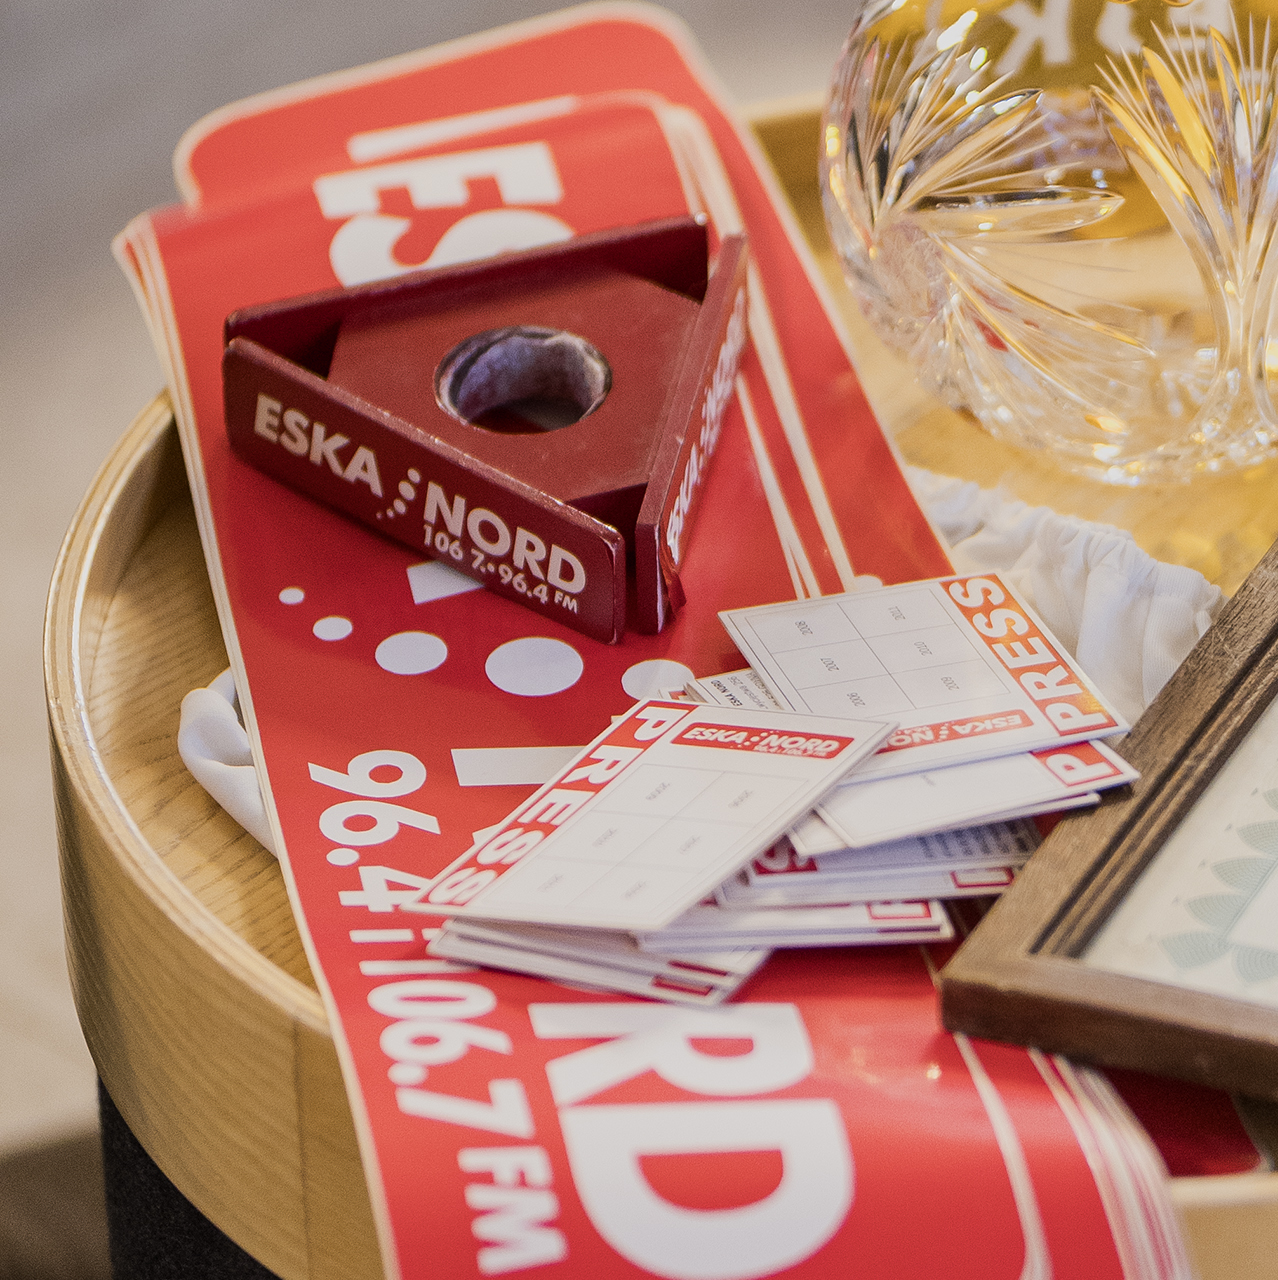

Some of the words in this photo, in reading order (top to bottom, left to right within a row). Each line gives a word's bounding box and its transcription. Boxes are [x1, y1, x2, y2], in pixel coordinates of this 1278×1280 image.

[252, 393, 384, 498] ESKA
[423, 481, 587, 595] NORD
[554, 590, 579, 614] FM
[948, 577, 1109, 732] PRESS
[682, 726, 749, 744] ESKA
[759, 733, 841, 753] NORD
[885, 729, 935, 748] NO
[952, 714, 1022, 735] ESKA
[307, 749, 441, 913] 96.4
[427, 706, 691, 906] PRESS
[357, 960, 537, 1141] 106.7
[456, 1144, 571, 1278] FM
